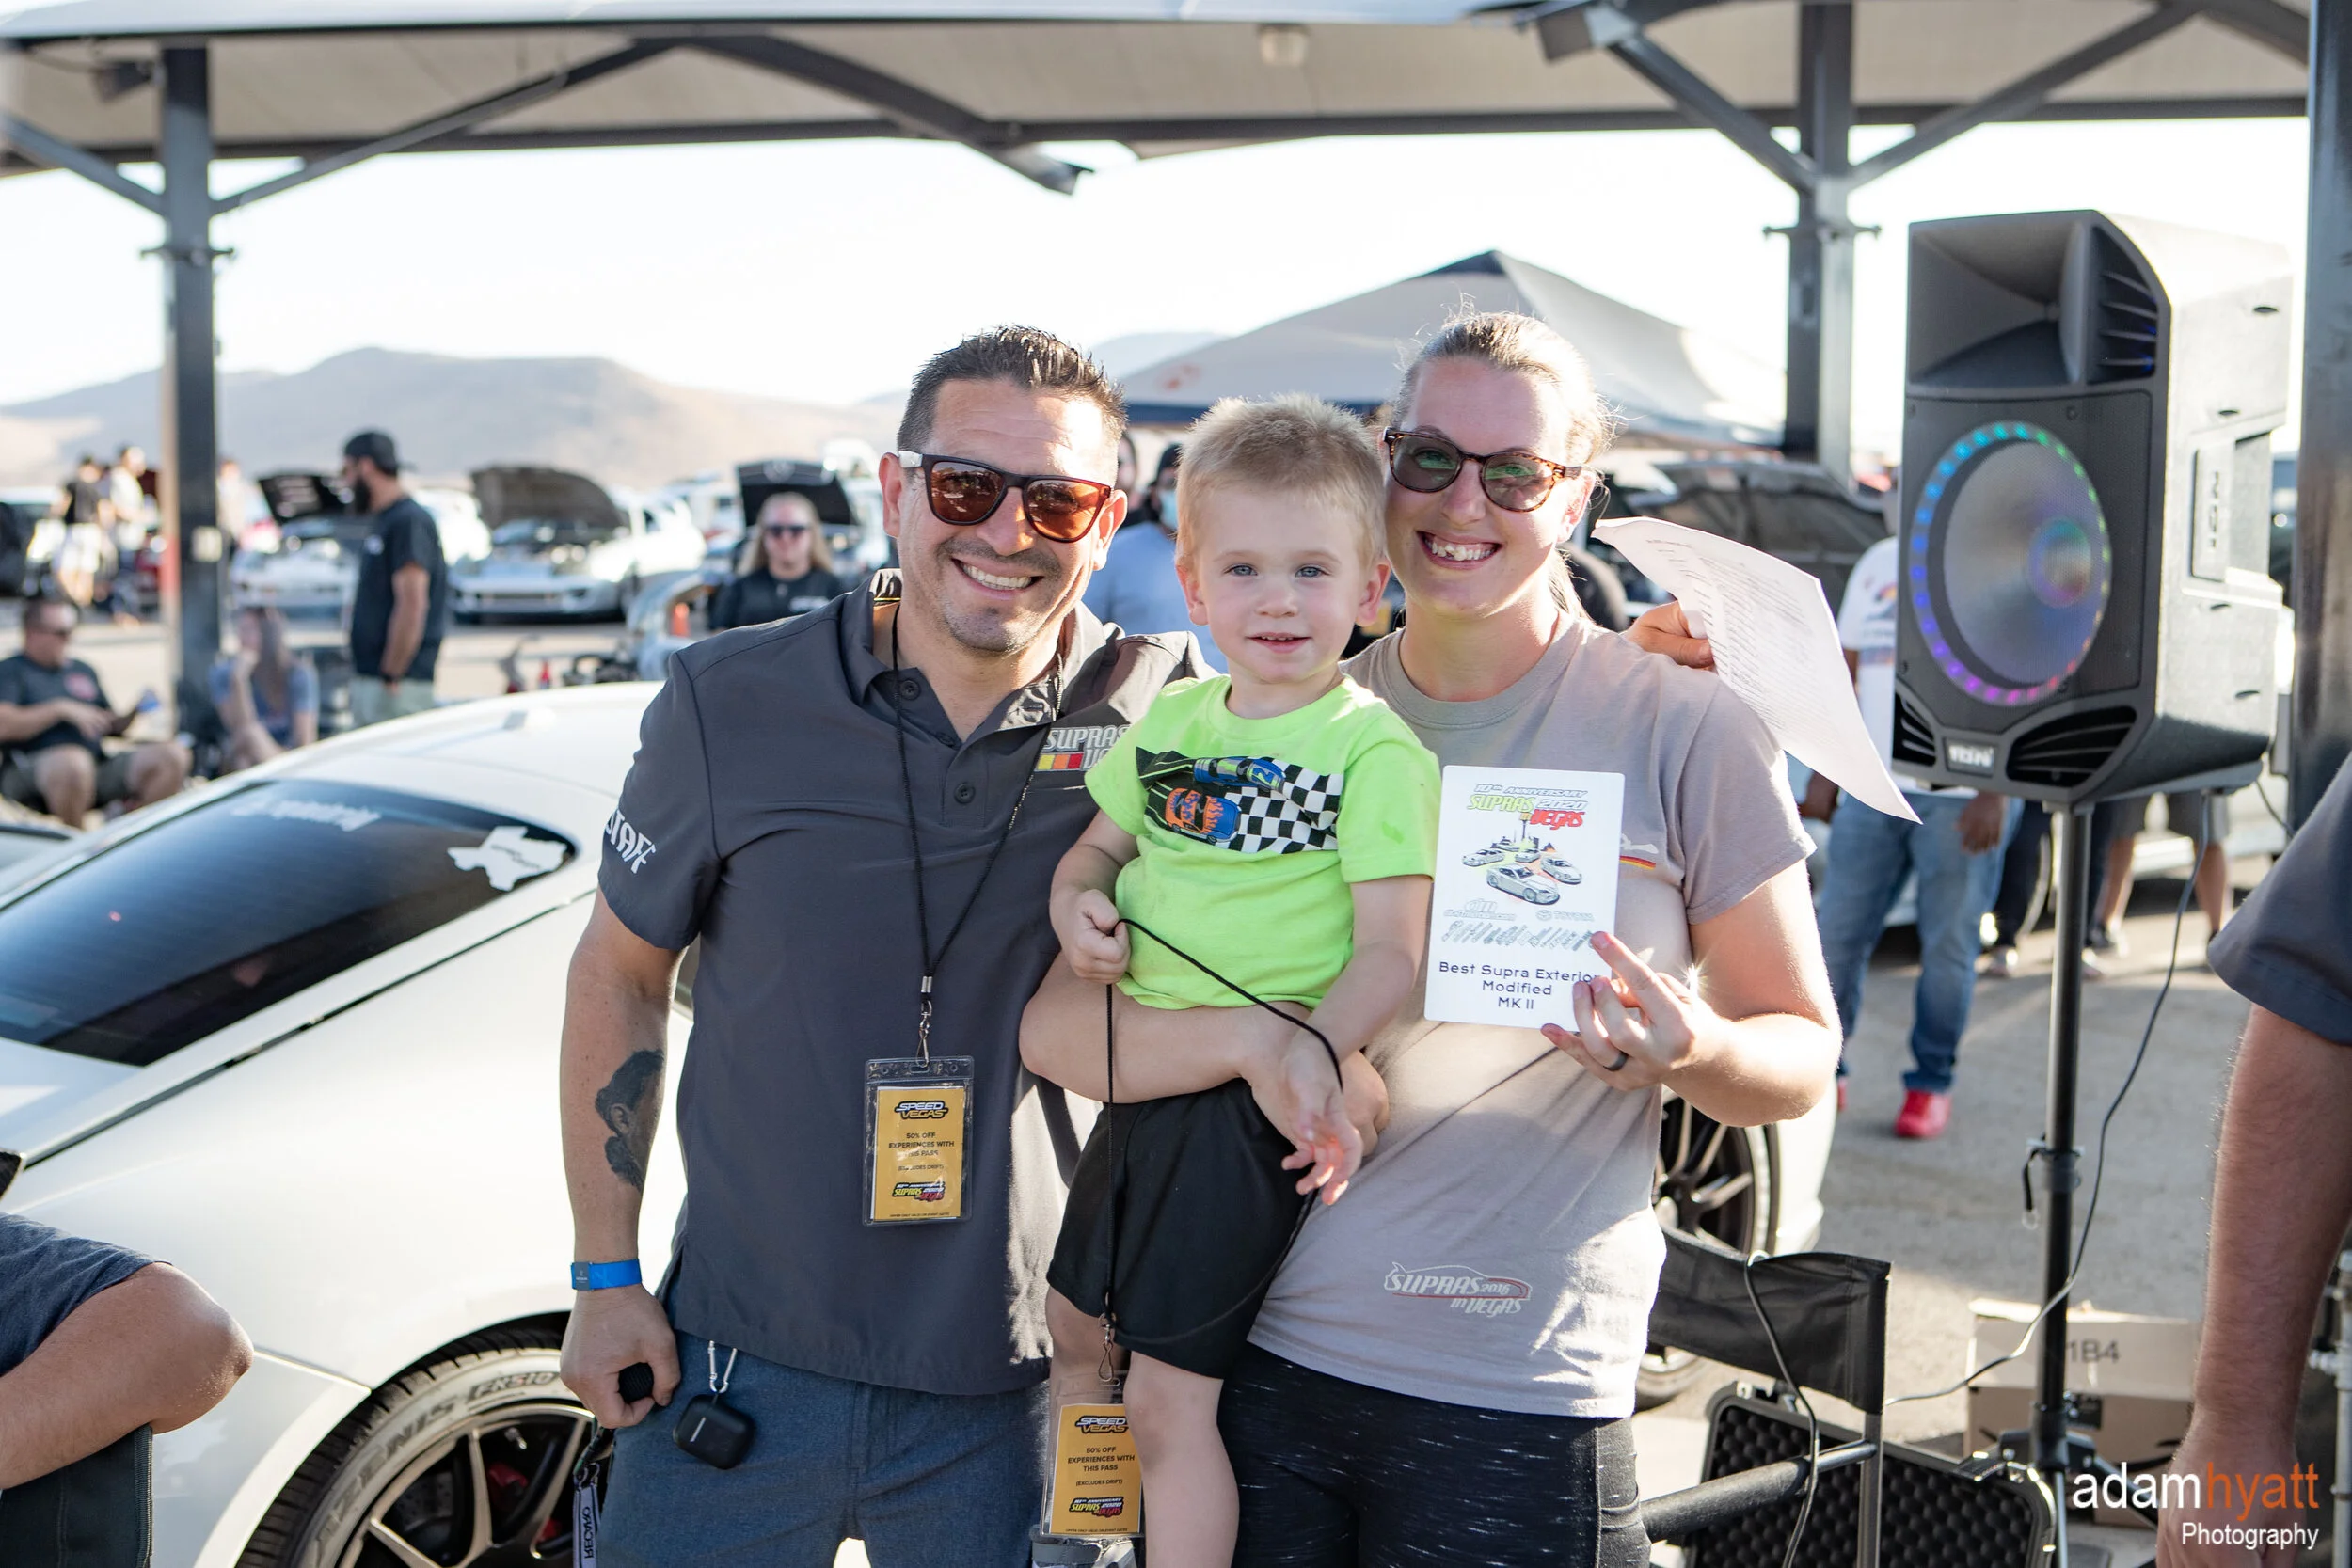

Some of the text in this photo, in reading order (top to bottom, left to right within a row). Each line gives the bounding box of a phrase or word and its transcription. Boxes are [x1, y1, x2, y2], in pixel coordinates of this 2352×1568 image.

[1503, 786, 1589, 798] ANNIVERSARY
[1466, 794, 1588, 813] SUPRAS 2020
[1529, 809, 1586, 831] VEGAS
[1438, 961, 1475, 974] Best
[1481, 964, 1530, 979] Supra
[1482, 980, 1553, 996] Modified
[1498, 996, 1521, 1009] MK
[895, 1101, 945, 1112] SPEED
[901, 1109, 947, 1118] VEGAS
[1388, 1274, 1511, 1295] SUPRAS 2016
[1465, 1298, 1522, 1318] VEGAS
[1076, 1417, 1126, 1426] SPEED
[1083, 1424, 1129, 1433] VEGAS
[1068, 1455, 1115, 1464] EXPERIENCES
